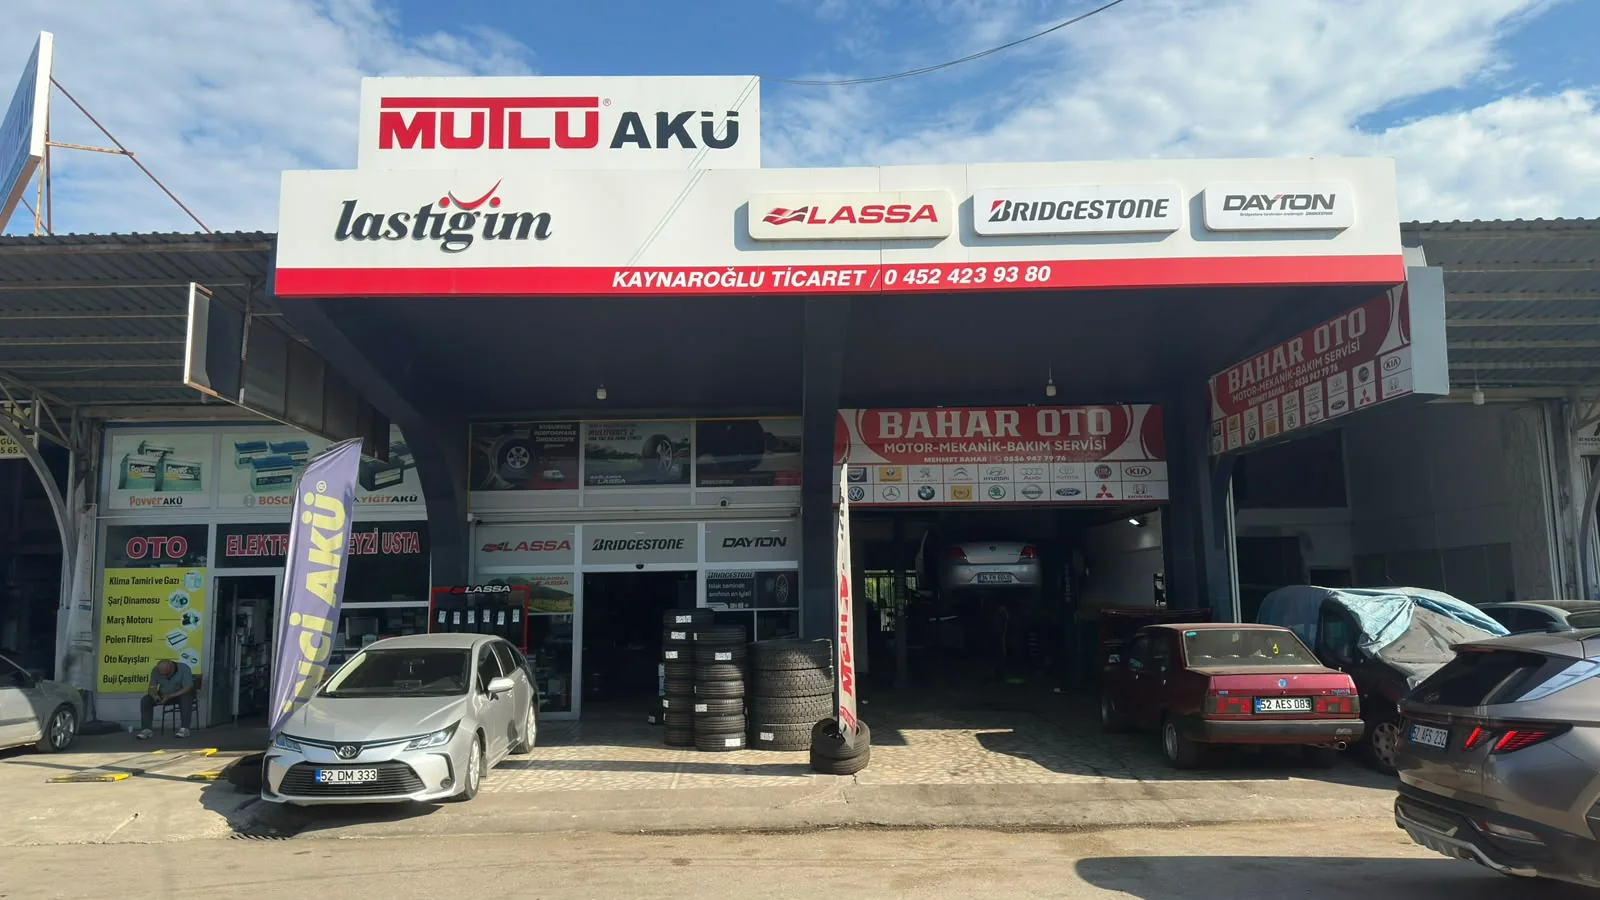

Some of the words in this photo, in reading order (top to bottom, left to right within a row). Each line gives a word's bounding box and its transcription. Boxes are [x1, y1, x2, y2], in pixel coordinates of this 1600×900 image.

[378, 96, 599, 150] MUTLU
[609, 110, 739, 150] AKÜ
[988, 198, 1169, 223] BRIDGESTONE
[1222, 194, 1336, 212] DAYTON
[334, 180, 552, 253] lastiğim
[807, 204, 938, 225] LASSA
[612, 266, 765, 288] KAYNAROĞLU
[770, 266, 867, 287] TİCARET
[884, 271, 897, 285] 0
[903, 269, 940, 285] 452
[947, 268, 986, 284] 423
[993, 267, 1019, 283] 93
[1024, 266, 1050, 282] 80
[1228, 337, 1304, 393] BAHAR
[1314, 307, 1366, 354] OTO
[1325, 342, 1360, 365] SERVİSİ
[878, 410, 1021, 439] BAHAR
[1036, 408, 1112, 437] OTO
[1055, 437, 1107, 451] SERVİSİ
[127, 536, 187, 559] OTO
[226, 534, 288, 556] ELEKTR
[348, 528, 378, 555] EYZİ
[381, 531, 420, 554] USTA
[502, 540, 571, 551] LASSA
[592, 538, 684, 551] BRIDGESTONE
[722, 537, 787, 548] DAYTON
[302, 492, 346, 608] AKÜ
[109, 577, 130, 585] Klima
[131, 576, 154, 585] Tamiri
[164, 577, 179, 585] Gazı
[465, 585, 511, 593] LASSA
[108, 596, 123, 606] Şarj
[123, 597, 160, 605] Dinamosu
[107, 616, 125, 625] Marş
[127, 615, 153, 624] Motoru
[105, 635, 126, 643] Polen
[127, 635, 152, 643] Filtresi
[104, 655, 117, 663] Oto
[118, 654, 149, 664] Kayışları
[103, 675, 117, 684] Buji
[118, 674, 149, 685] Çeşitleri
[1261, 699, 1271, 709] 52
[1275, 699, 1292, 709] AES
[1434, 730, 1447, 746] 232
[321, 771, 333, 781] 52
[338, 770, 354, 780] DM
[357, 770, 376, 780] 333
